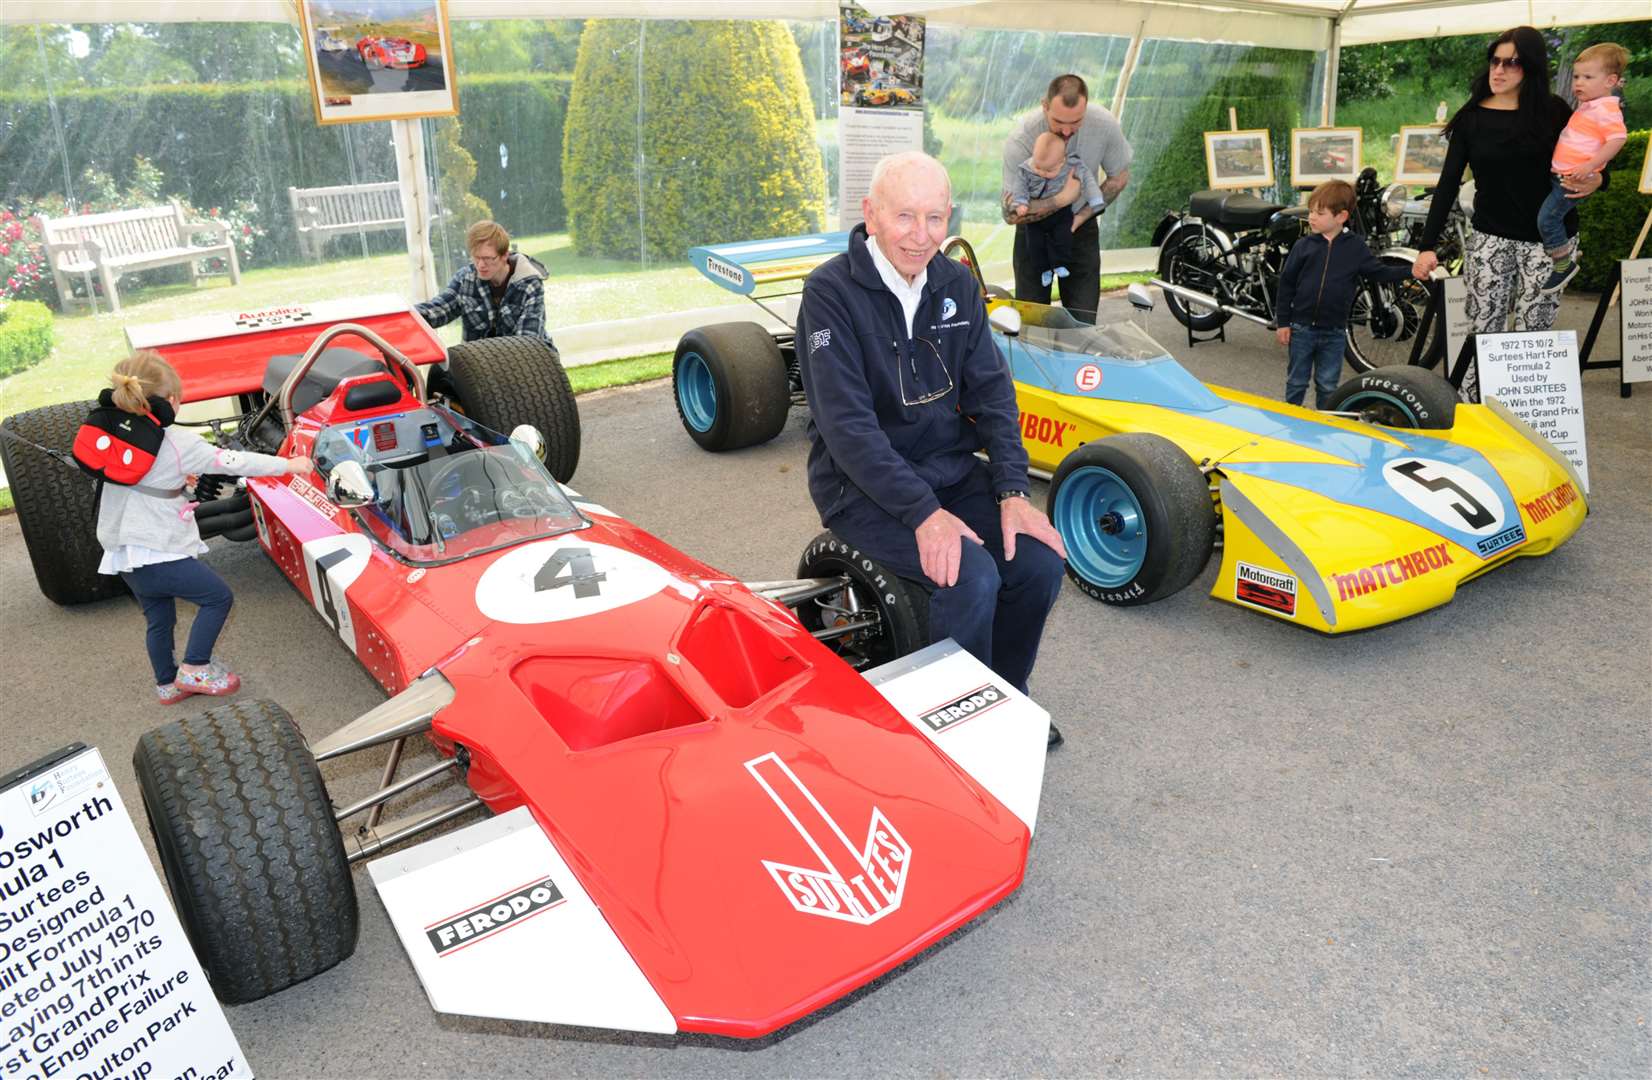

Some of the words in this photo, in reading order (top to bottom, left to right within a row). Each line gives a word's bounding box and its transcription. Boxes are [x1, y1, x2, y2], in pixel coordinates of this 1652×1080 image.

[706, 257, 743, 283] Firestone
[1488, 352, 1524, 362] Surtees
[1525, 351, 1545, 360] Hart
[1547, 349, 1568, 359] Ford
[1501, 340, 1520, 350] 1972
[1522, 339, 1534, 349] TS
[1536, 338, 1554, 348] 10/2
[1081, 369, 1096, 386] E
[1507, 363, 1543, 372] Formula
[1545, 361, 1551, 370] 2
[1512, 373, 1535, 383] Used
[1537, 373, 1548, 384] by
[1361, 377, 1429, 419] Firestone
[1496, 386, 1520, 396] JOHN
[1523, 383, 1567, 395] SURTEES
[1510, 398, 1527, 407] Win
[1529, 398, 1543, 406] the
[1546, 396, 1565, 405] 1972
[1531, 406, 1559, 417] Grand
[1561, 405, 1580, 415] Prix
[1539, 418, 1556, 427] and
[1550, 429, 1569, 439] Cup
[1392, 460, 1497, 530] 5
[1476, 528, 1526, 554] SURTEES
[534, 548, 607, 599] 4
[804, 540, 896, 606] Firestone
[1240, 566, 1294, 591] Motorcraft
[927, 690, 999, 728] FERODO
[48, 849, 65, 869] 1
[788, 830, 904, 920] SURTEES
[436, 887, 552, 947] FERODO
[26, 906, 122, 971] Formula
[123, 893, 135, 910] 1
[0, 971, 56, 1022] eted
[59, 944, 103, 982] July
[106, 909, 155, 948] 1970
[72, 967, 113, 998] 7th
[111, 953, 134, 973] in
[133, 934, 162, 960] its
[32, 996, 105, 1054] Grand
[103, 969, 151, 1006] Prix
[40, 1018, 120, 1079] Engine
[118, 969, 189, 1023] Failure
[146, 1001, 197, 1042] Park
